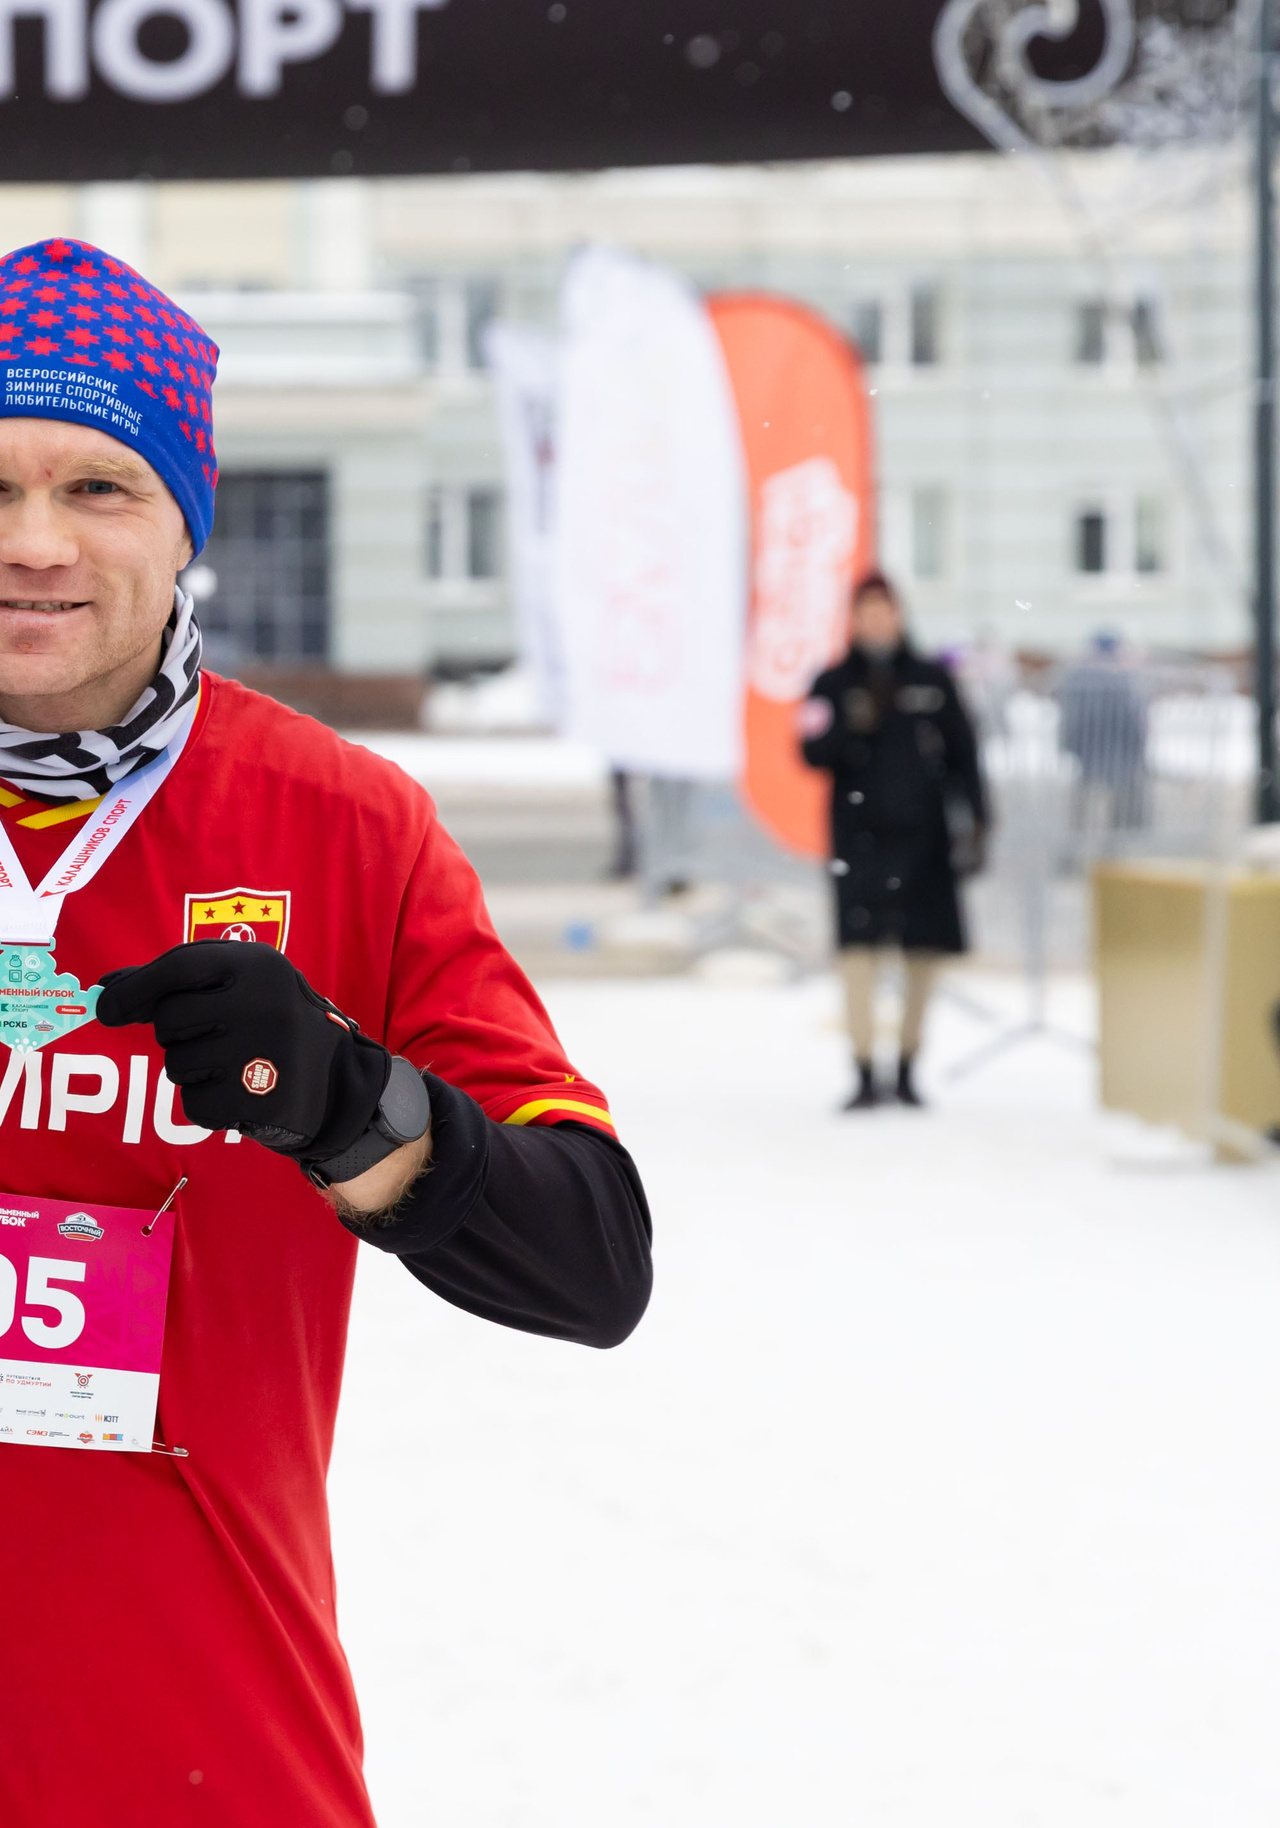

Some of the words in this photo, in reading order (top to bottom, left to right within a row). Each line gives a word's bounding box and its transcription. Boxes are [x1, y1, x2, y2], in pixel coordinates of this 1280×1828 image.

[7, 368, 118, 395] ВСЕРОССИЙСКИЕ
[5, 394, 108, 419] ЛЮБИТЕЛЬСКИЕ
[111, 414, 139, 436] ИГРЫ
[6, 381, 62, 394] ЗИМНИЕ
[66, 385, 143, 425] СПОРТИВНЫЕ
[55, 826, 110, 887] КАЛАШНИКОВ
[102, 798, 132, 825] СПОРТ
[42, 989, 75, 998] КУБОК
[60, 1225, 102, 1237] ВОСТОЧНЫЙ
